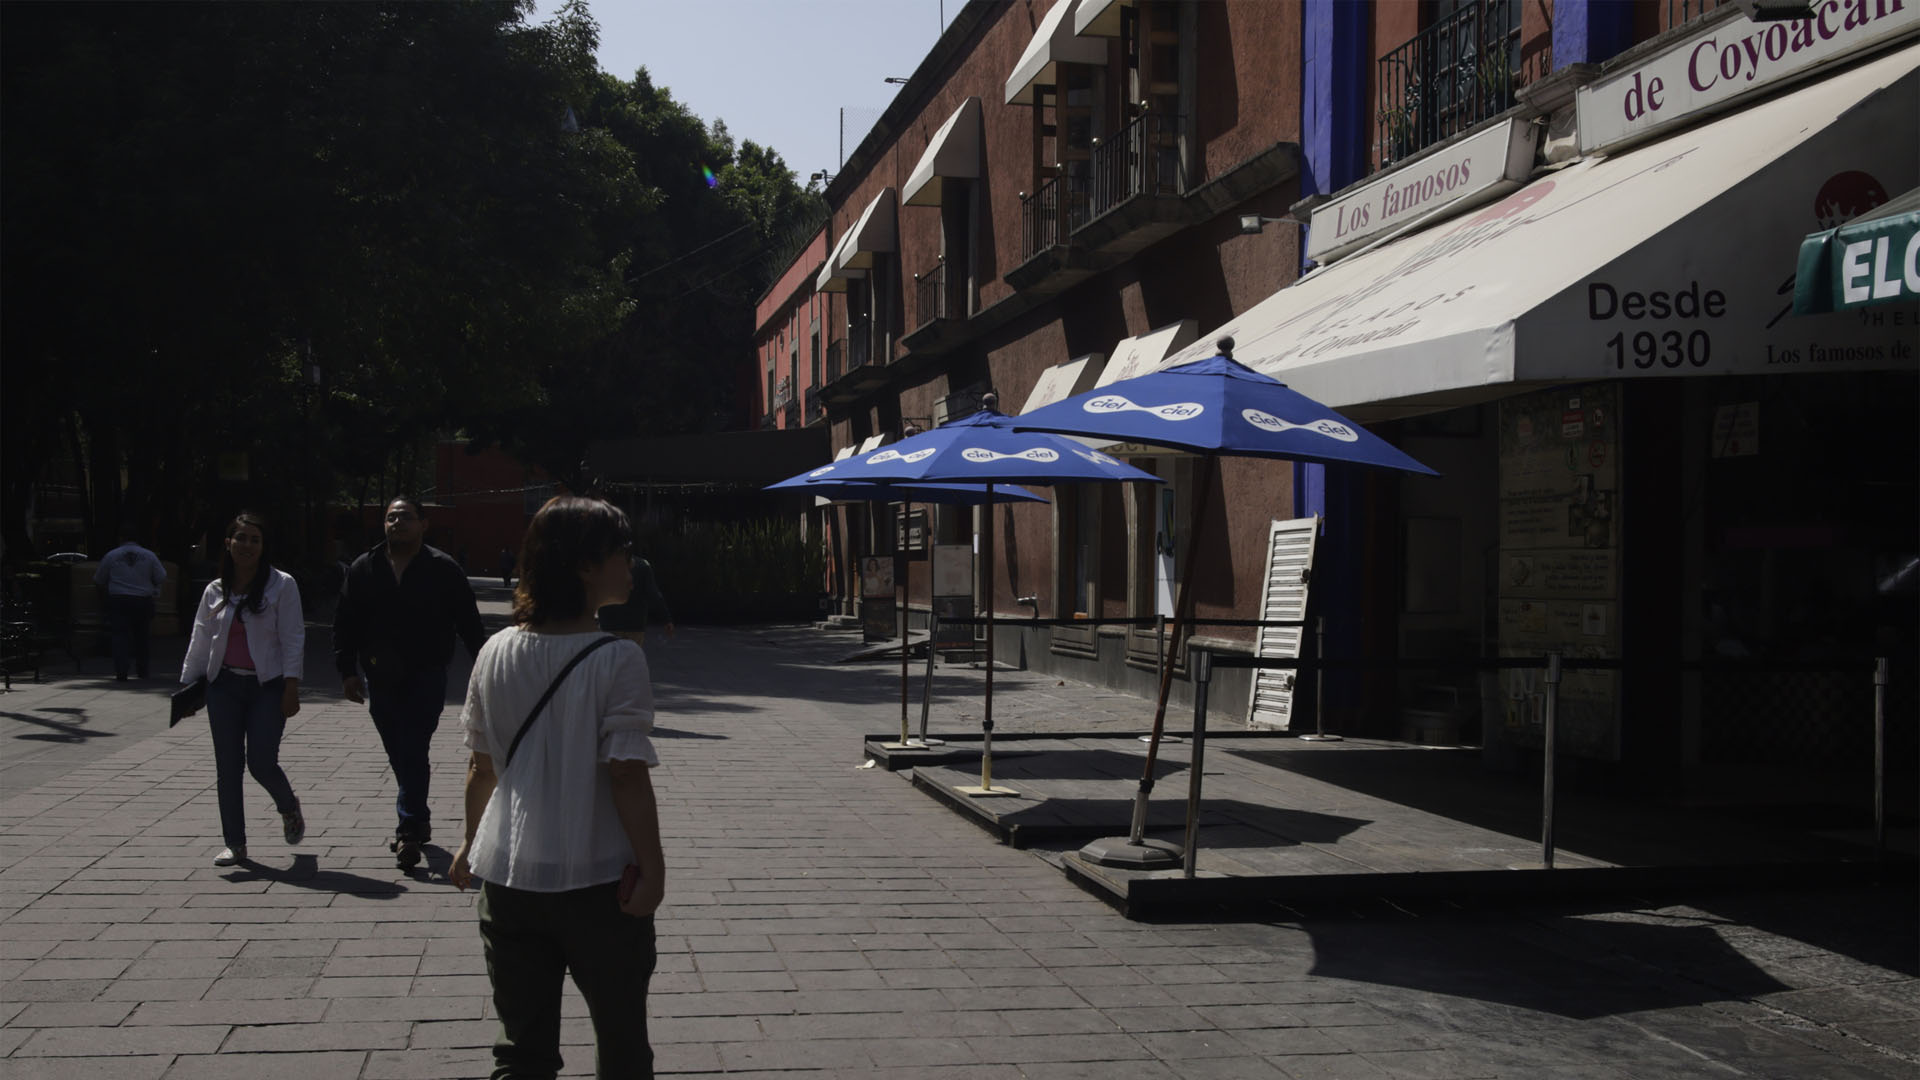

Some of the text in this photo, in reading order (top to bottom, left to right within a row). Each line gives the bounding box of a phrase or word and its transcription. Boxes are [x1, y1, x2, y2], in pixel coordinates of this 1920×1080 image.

[1624, 72, 1665, 121] de
[1335, 157, 1472, 239] Los famosos
[1588, 280, 1728, 321] Desde
[1606, 329, 1712, 370] 1930
[1767, 340, 1912, 364] Los famosos de
[1090, 398, 1196, 416] ciel ciel
[1248, 412, 1352, 436] ciel ciel
[966, 450, 1054, 459] ciel ciel
